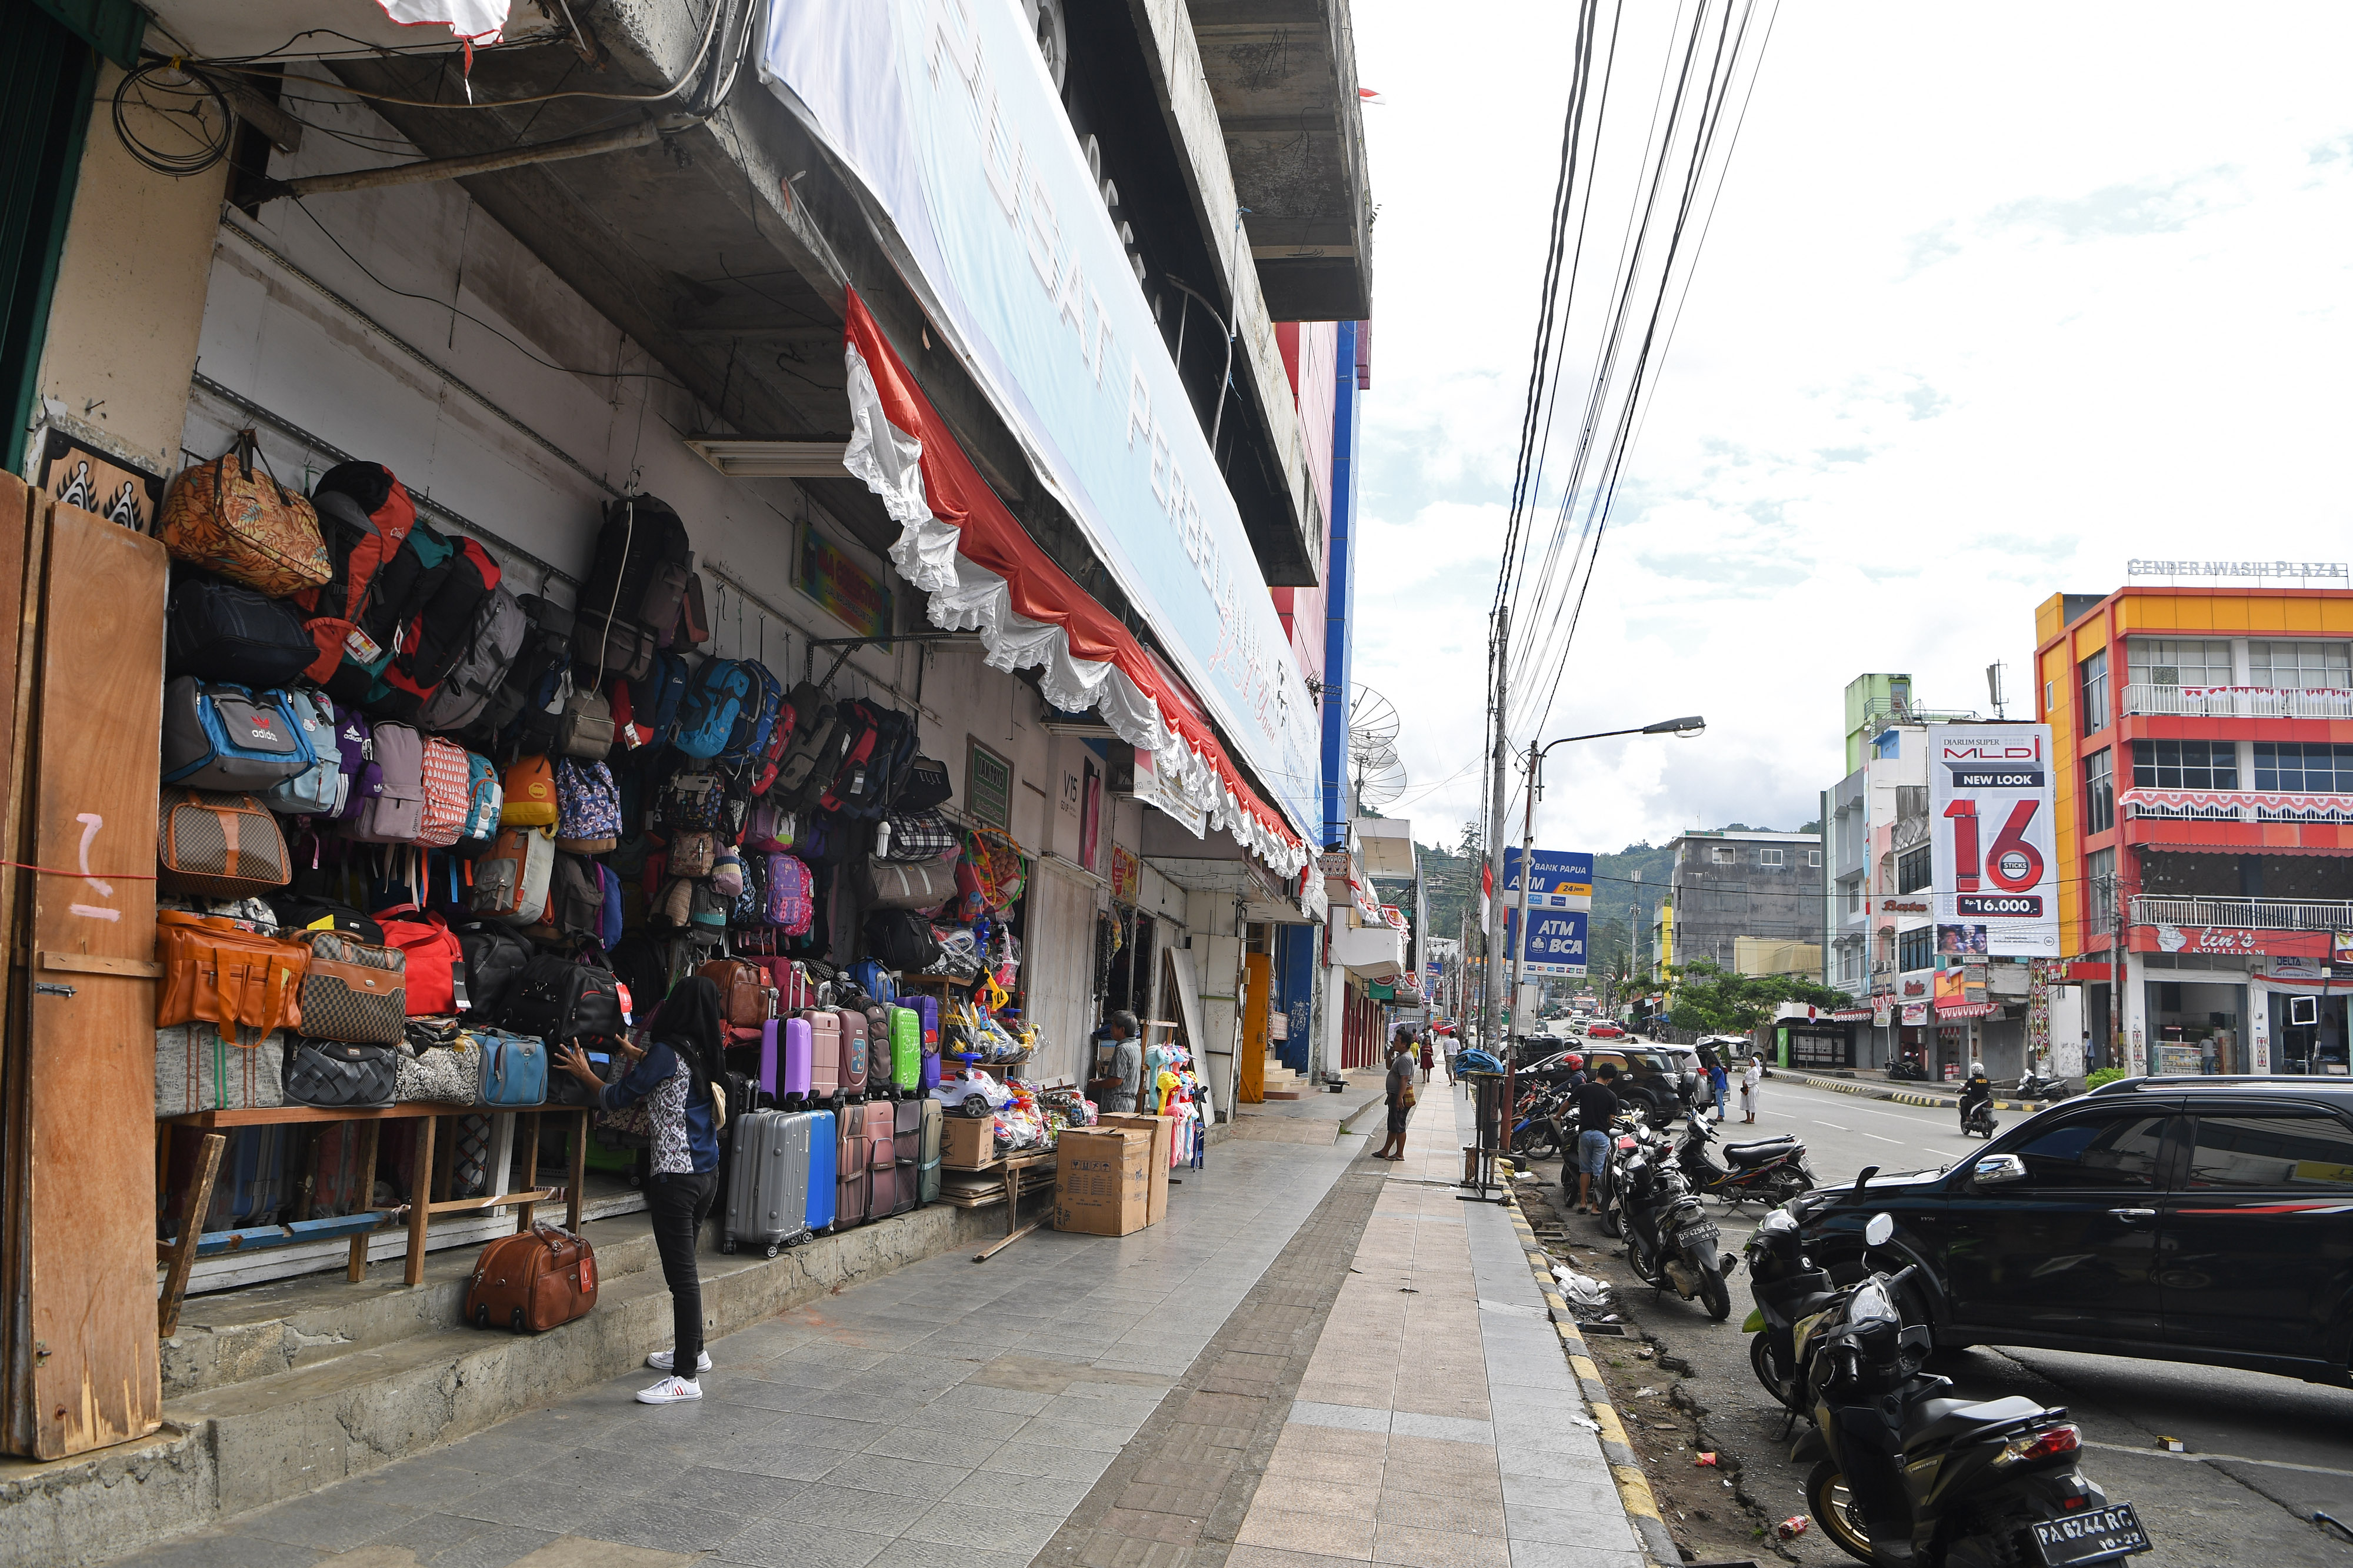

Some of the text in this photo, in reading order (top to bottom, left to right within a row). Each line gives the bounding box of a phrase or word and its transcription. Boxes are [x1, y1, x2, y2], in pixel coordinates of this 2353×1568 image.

[2128, 559, 2340, 577] CENDERAWASIH PLAZA
[252, 729, 278, 742] adidas
[344, 733, 362, 742] adidas
[1944, 748, 2032, 758] MLD
[919, 771, 941, 784] ELLE
[1964, 775, 2032, 785] NEW LOOK
[1064, 770, 1078, 803] V15
[1944, 799, 2044, 893] 16
[1535, 863, 1586, 874] BANK PAPUA
[1882, 900, 1928, 912] Bata
[1538, 920, 1575, 936] ATM
[1548, 939, 1582, 955] BCA
[2192, 947, 2265, 956] KOPITIAM
[2277, 956, 2302, 966] DELTA
[1678, 1223, 1716, 1240] DS 4258 AJ
[2038, 1510, 2132, 1545] PA 6244 RC
